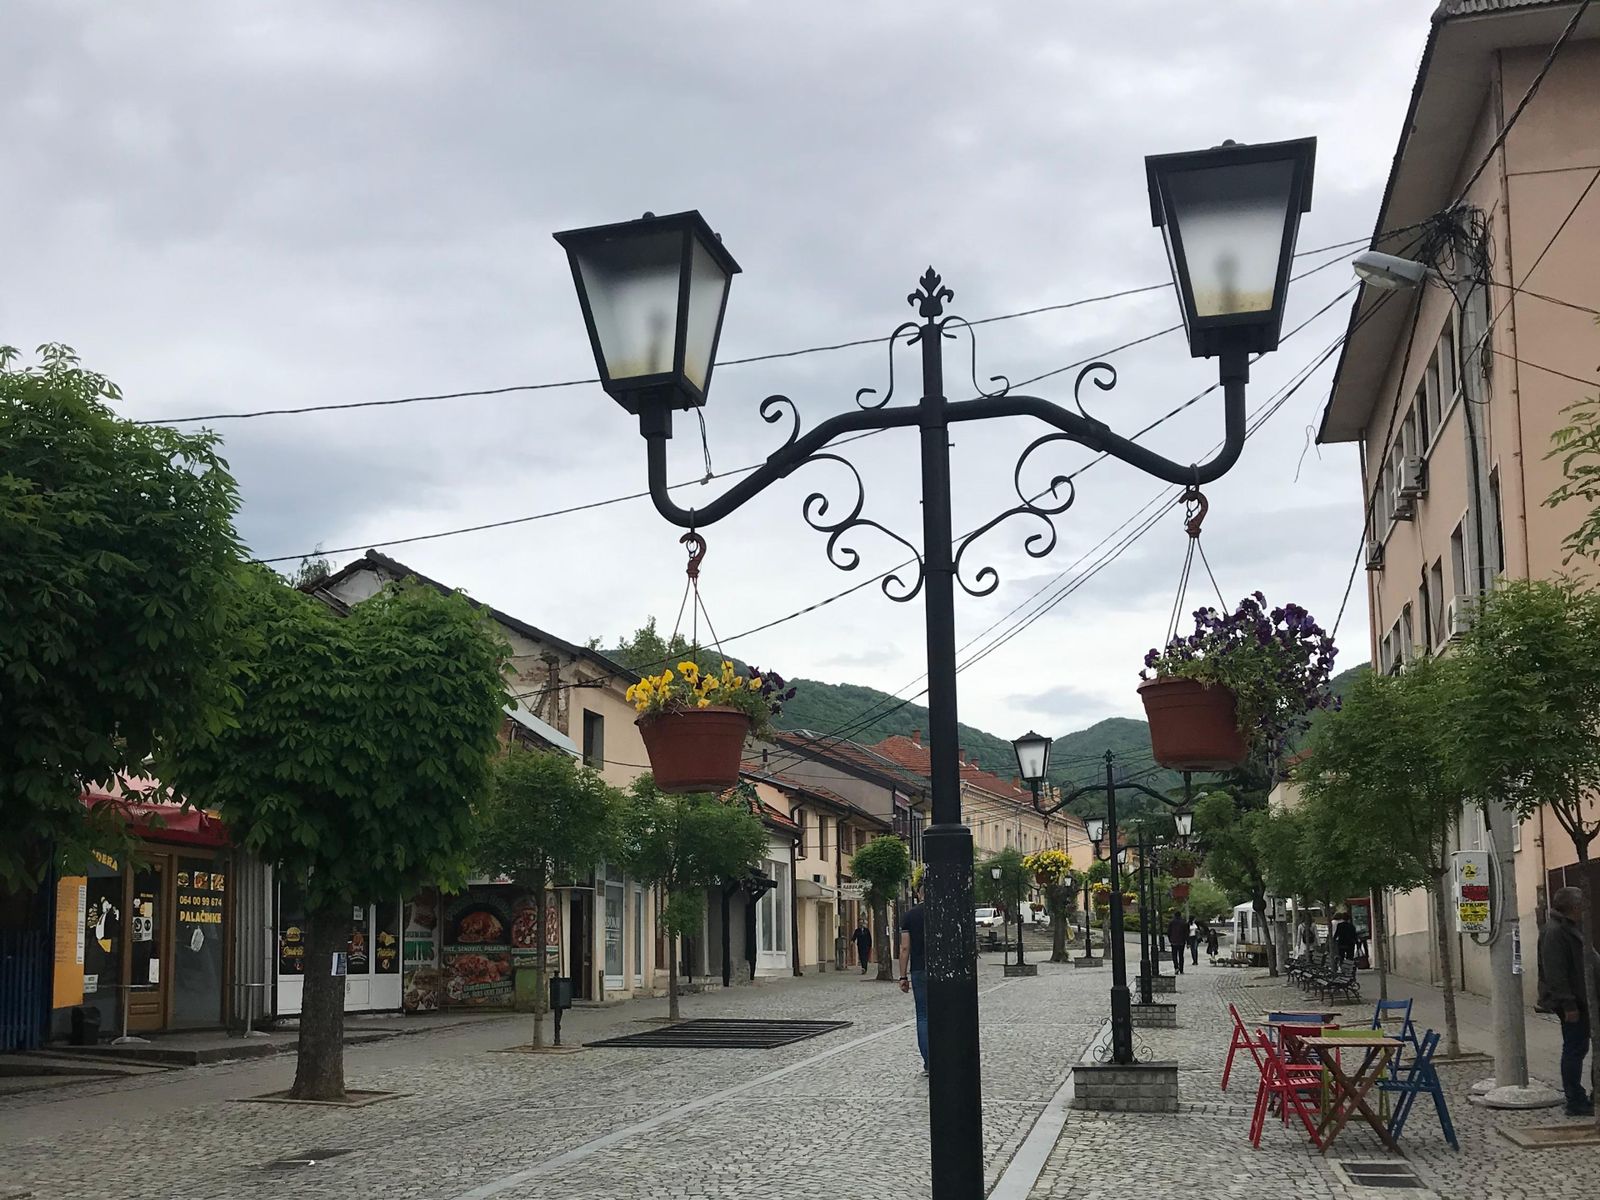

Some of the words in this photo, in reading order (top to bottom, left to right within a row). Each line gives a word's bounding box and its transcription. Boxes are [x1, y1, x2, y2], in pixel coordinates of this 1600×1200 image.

[179, 895, 191, 905] 064
[192, 896, 201, 905] 00
[201, 896, 210, 906] 99
[179, 909, 222, 924] PALAČINKE
